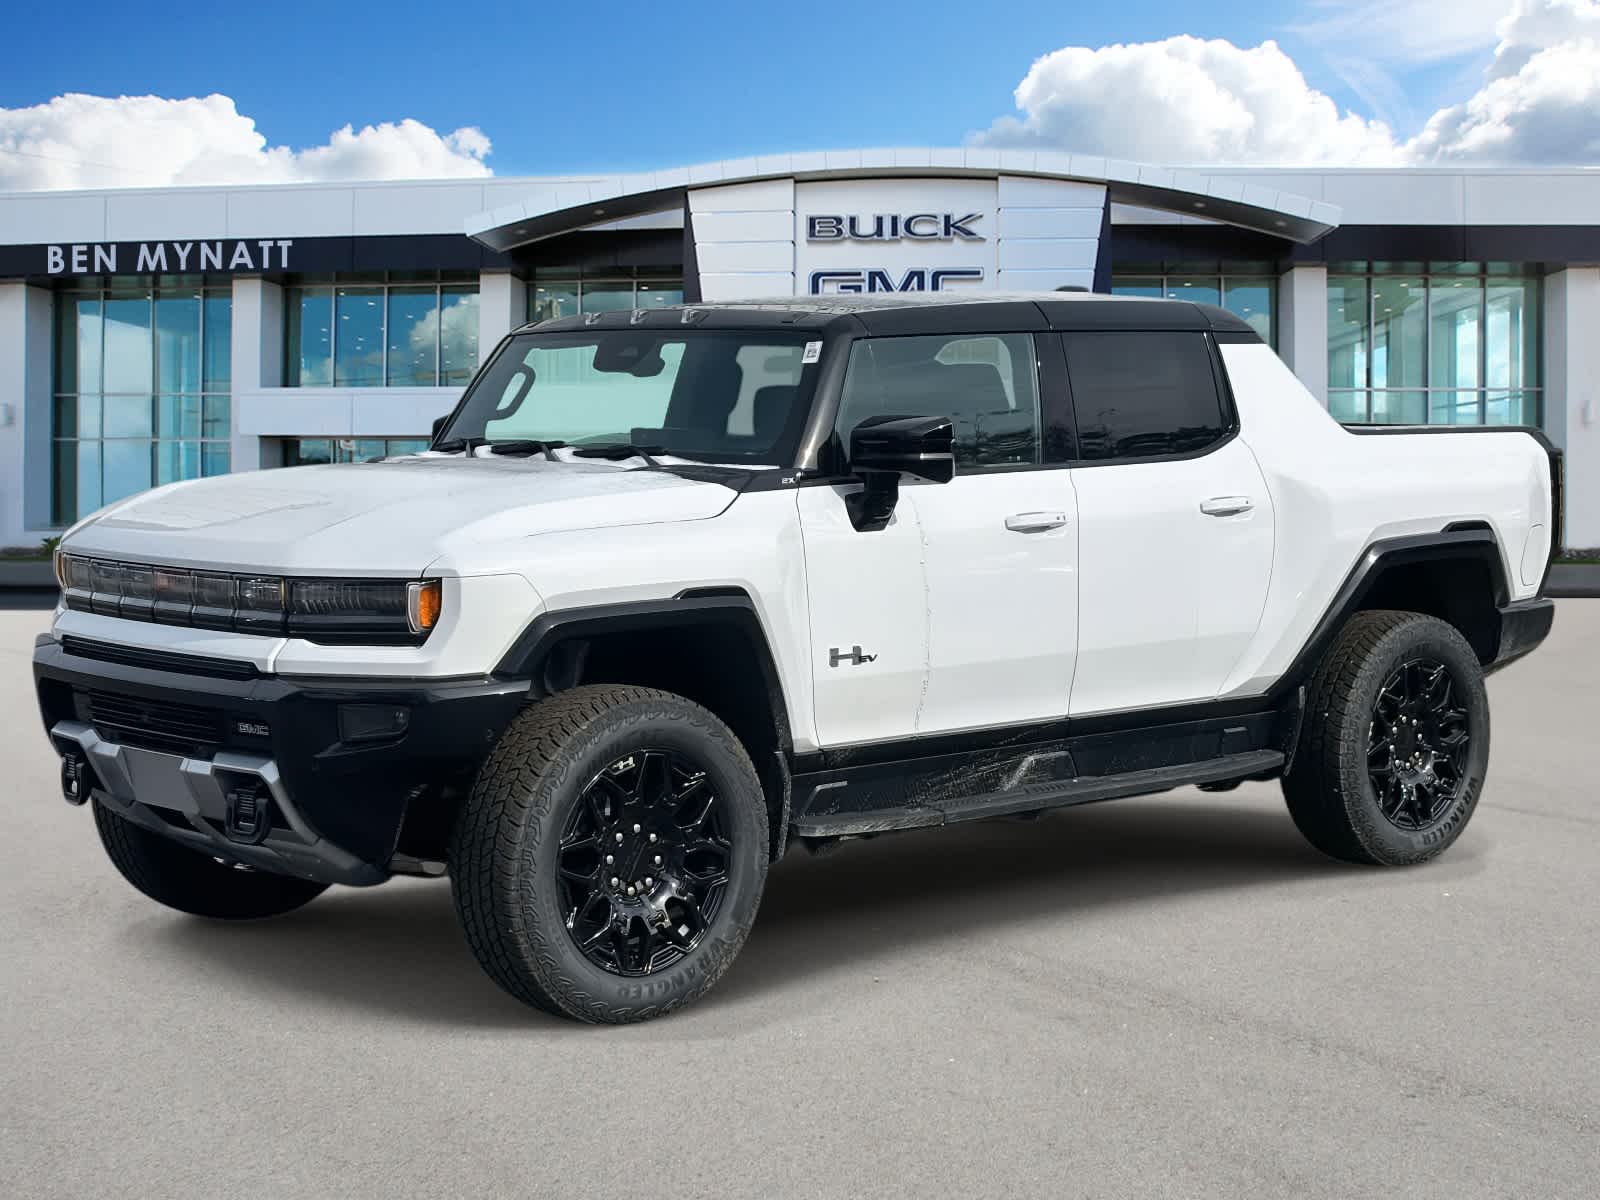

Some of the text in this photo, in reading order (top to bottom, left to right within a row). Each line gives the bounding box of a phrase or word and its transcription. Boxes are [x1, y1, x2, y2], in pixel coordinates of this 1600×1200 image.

[807, 214, 985, 241] BUICK
[47, 240, 293, 274] BEN MYNATT
